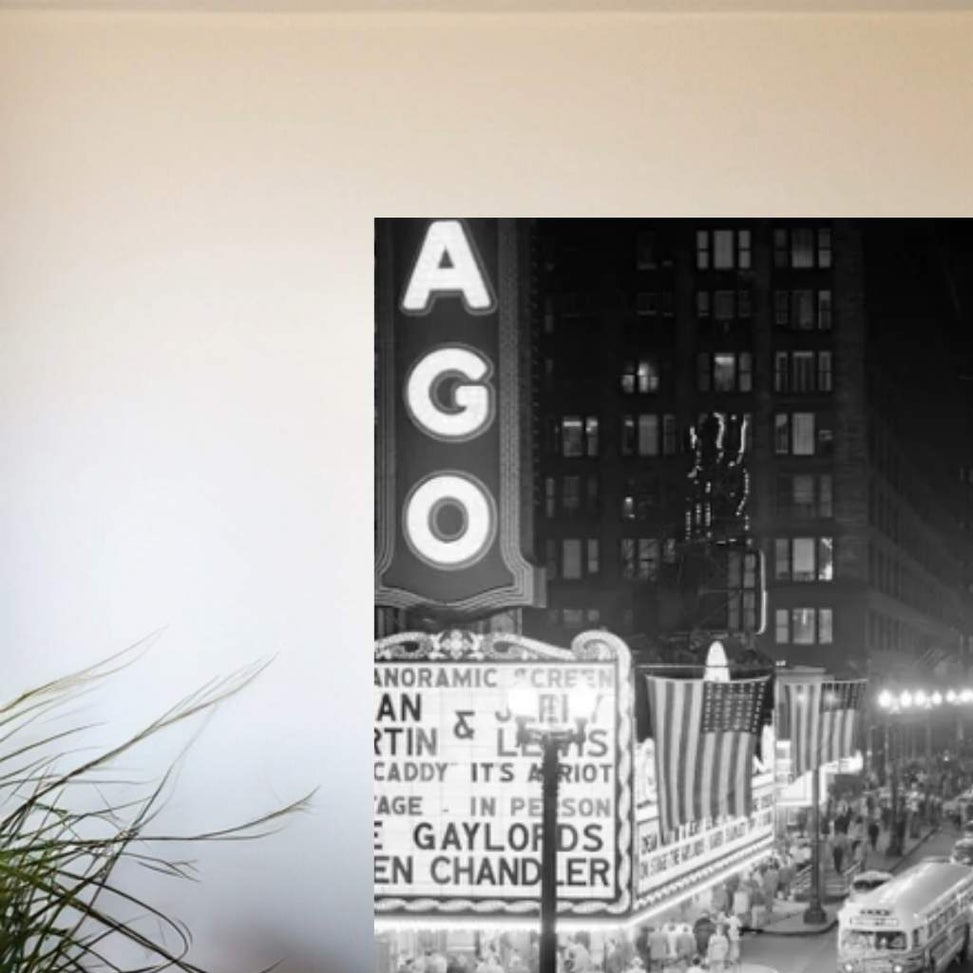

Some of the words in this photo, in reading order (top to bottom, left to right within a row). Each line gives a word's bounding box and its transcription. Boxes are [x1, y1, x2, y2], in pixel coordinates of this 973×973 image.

[401, 220, 495, 567] AGO
[376, 693, 421, 721] AN
[374, 763, 448, 781] CADDY
[374, 796, 423, 816] AGE
[470, 797, 496, 817] IN
[511, 798, 611, 817] PESON
[374, 856, 413, 884] EN
[430, 856, 611, 886] CHANDER
